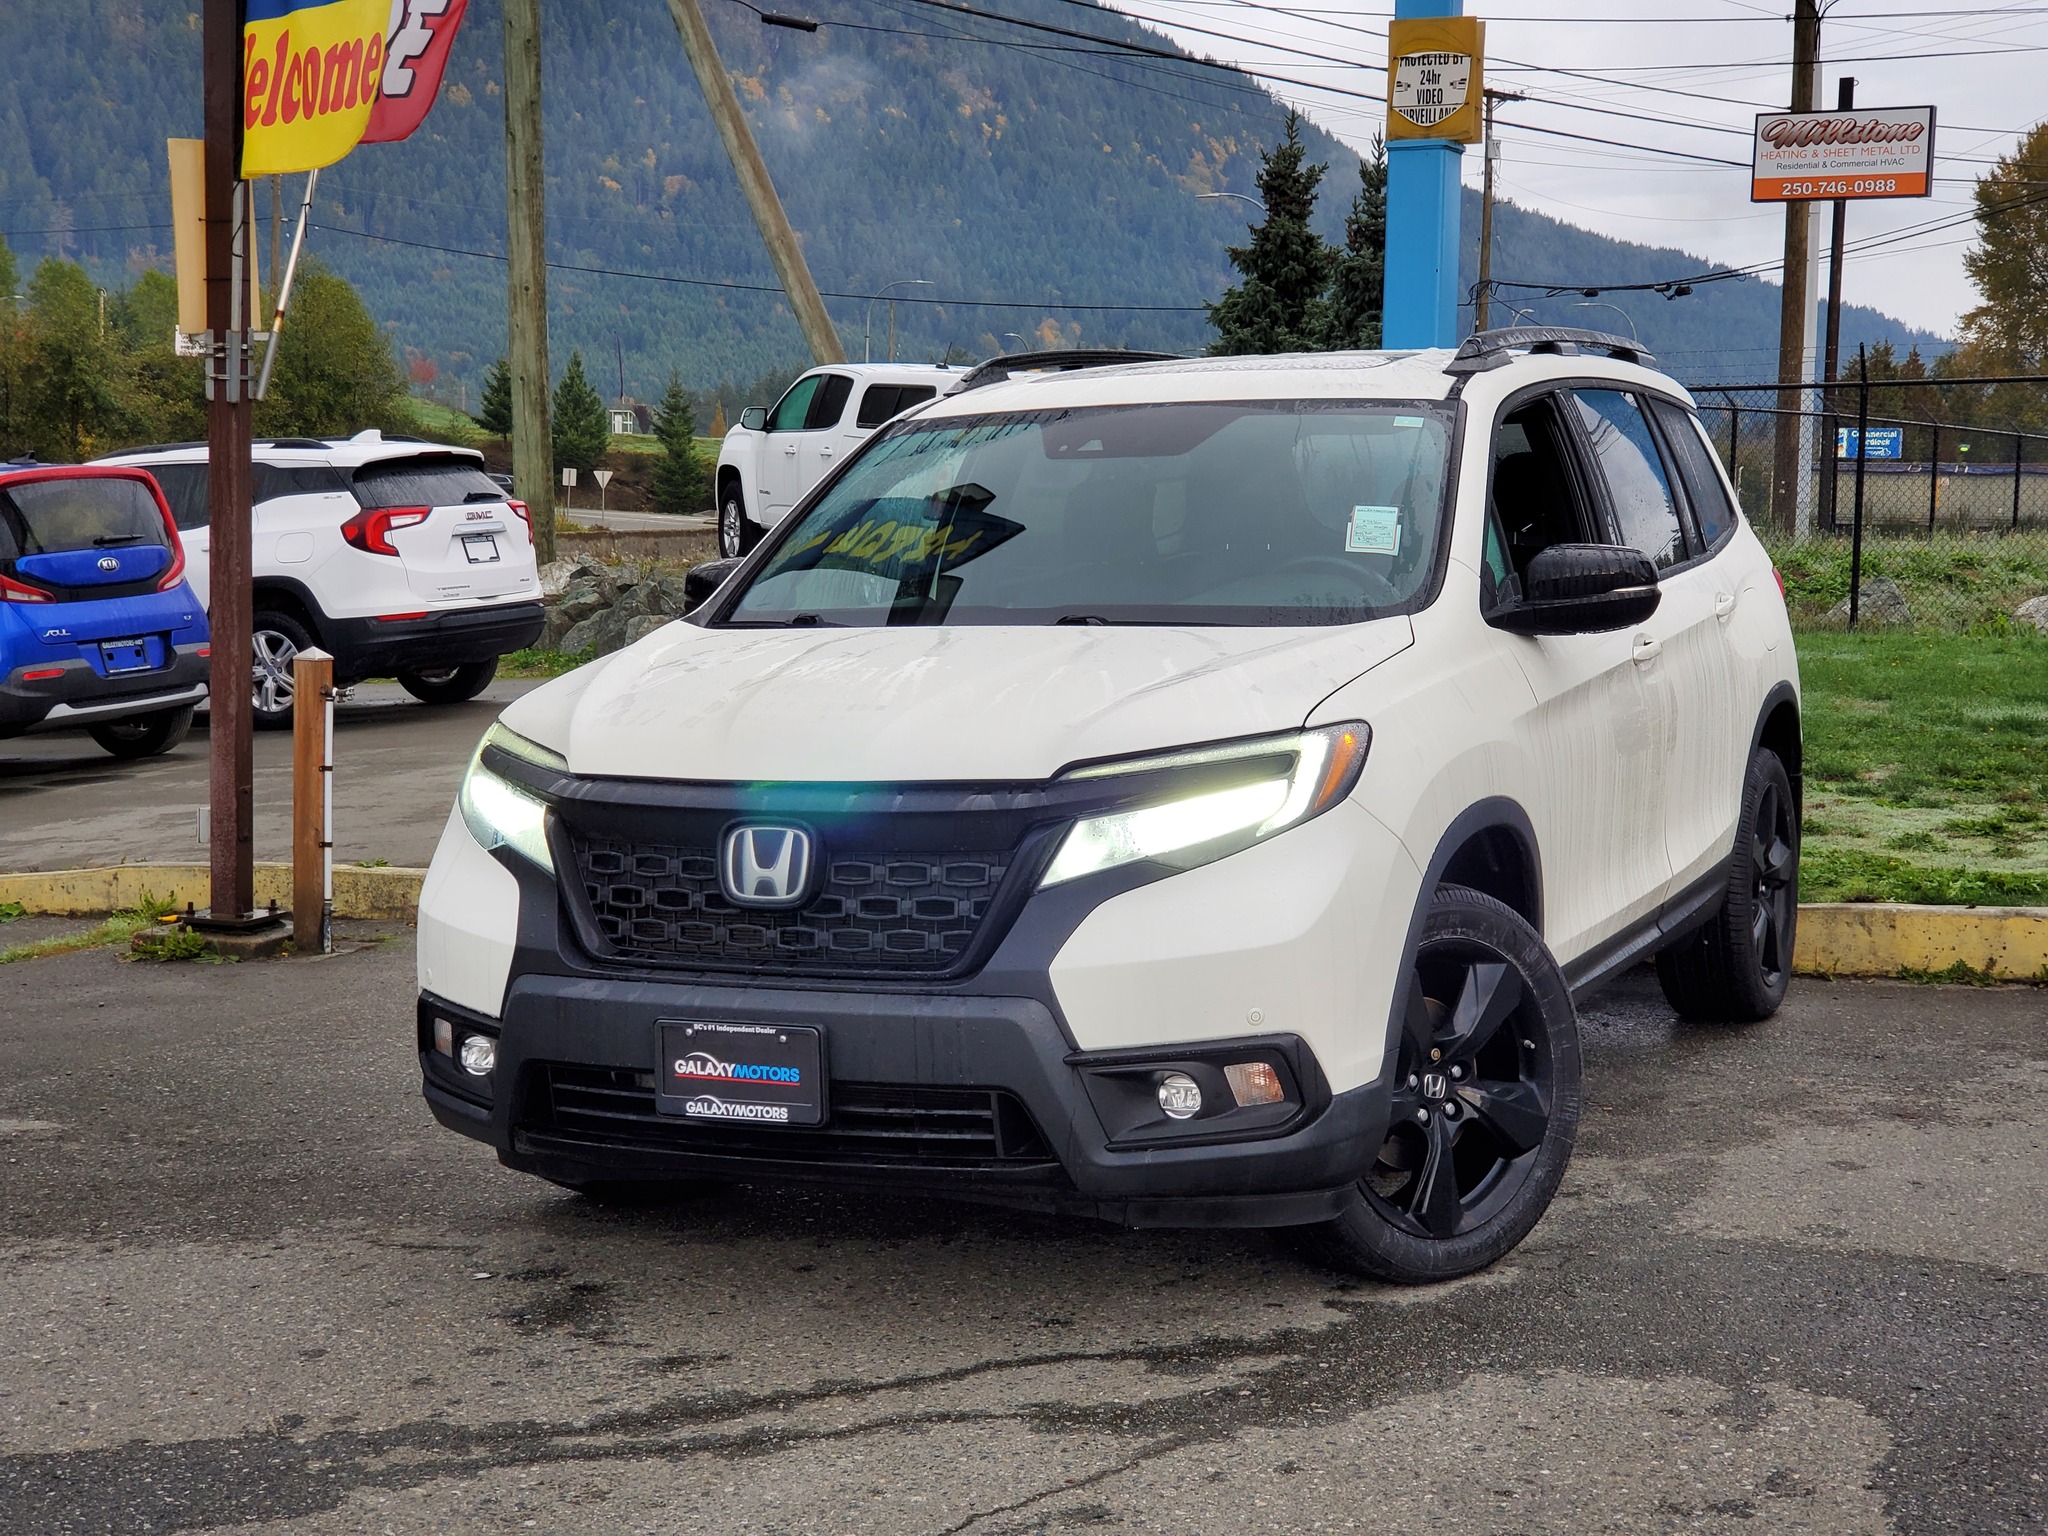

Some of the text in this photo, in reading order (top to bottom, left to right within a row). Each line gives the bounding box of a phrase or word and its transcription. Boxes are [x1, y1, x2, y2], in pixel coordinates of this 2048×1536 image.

[244, 28, 383, 131] elcome
[1419, 69, 1442, 86] 24hr
[1416, 88, 1443, 105] VIDEO
[1760, 117, 1925, 150] Millstone
[1760, 145, 1923, 160] HEATING & SHEET METAL LTD.
[1776, 157, 1905, 171] Residential & Commercial HVAC
[1781, 179, 1896, 196] 250-746-0988
[465, 511, 493, 520] GMC
[101, 558, 117, 570] KIA
[716, 1025, 756, 1035] Independent
[756, 1027, 777, 1035] Dealer
[686, 1101, 788, 1120] GALAXYMOTORS
